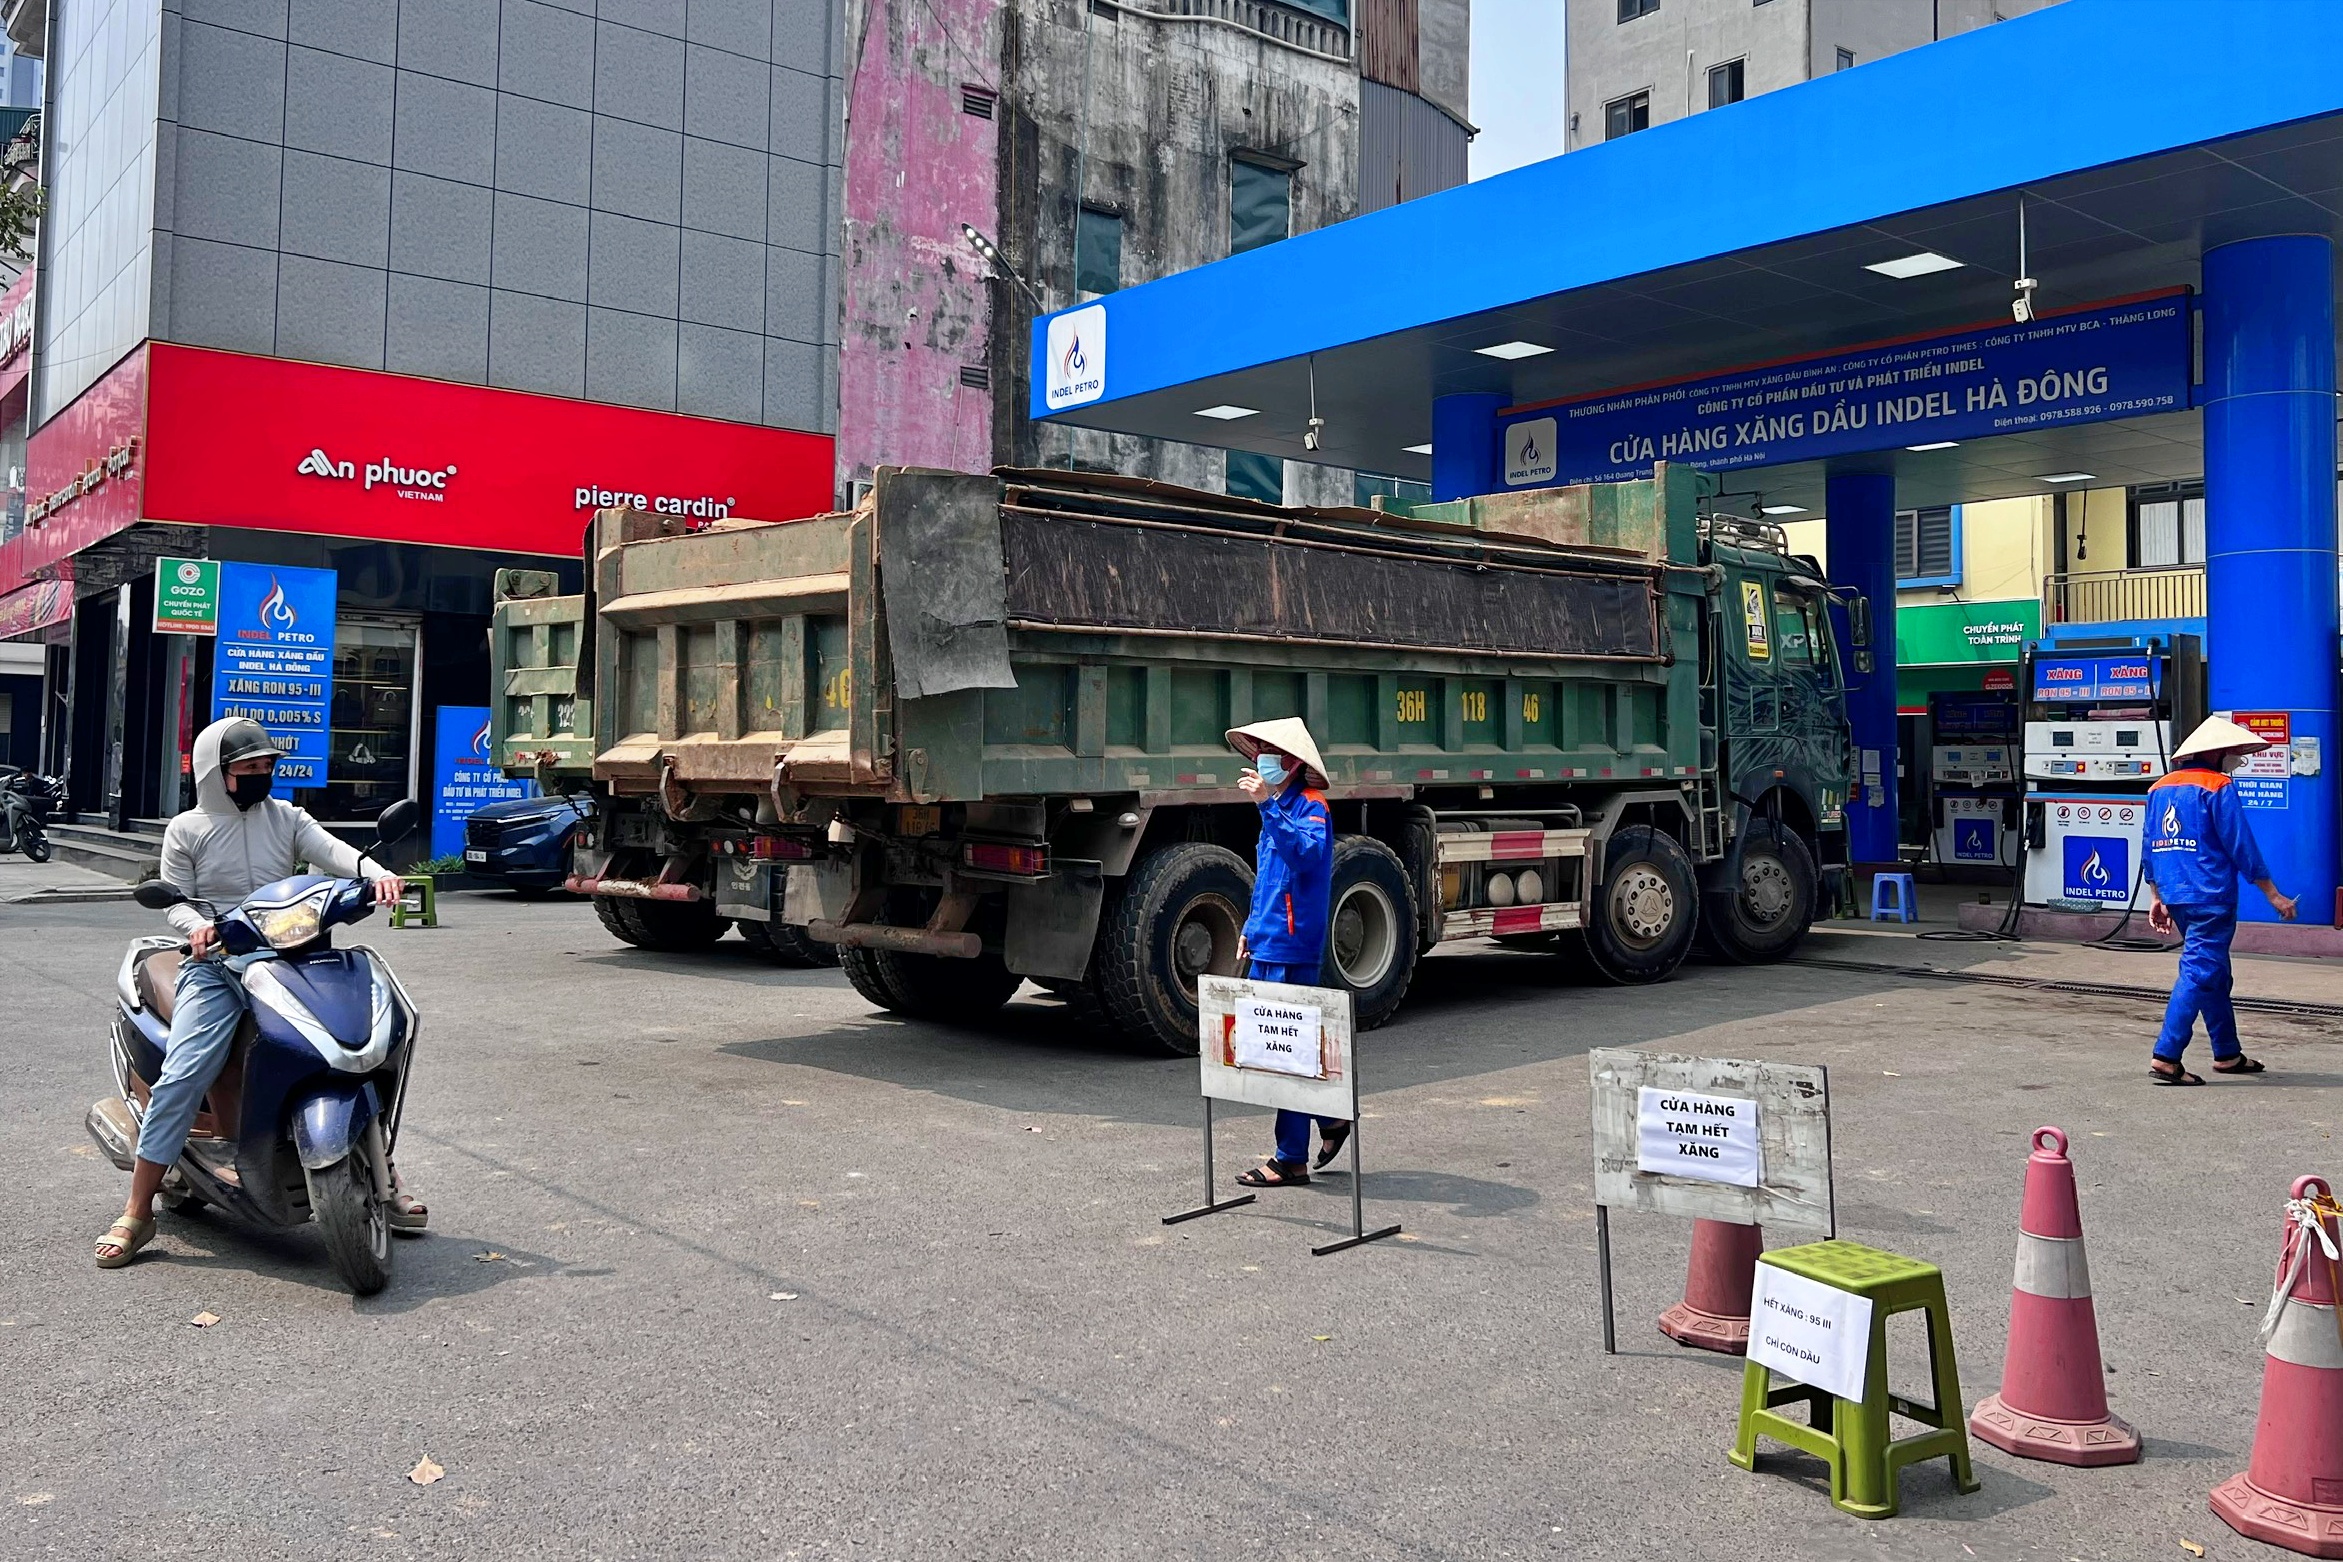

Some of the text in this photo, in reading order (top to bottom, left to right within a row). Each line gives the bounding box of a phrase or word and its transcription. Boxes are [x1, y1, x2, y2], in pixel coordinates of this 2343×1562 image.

[1711, 386, 1720, 394] TY
[1722, 383, 1742, 392] TNHH
[1744, 379, 1760, 389] MTV
[1825, 365, 1837, 374] AN
[1868, 358, 1879, 366] TY
[1920, 346, 1949, 358] PETRO
[1951, 341, 1977, 353] TIMES
[1985, 335, 2011, 347] CÔNG
[2013, 333, 2025, 343] TY
[2028, 328, 2054, 340] TNHH
[2056, 324, 2078, 335] MTV
[2080, 320, 2100, 331] BCA
[1052, 379, 1099, 399] INDEL PETRO
[1698, 400, 1728, 415] CÔNG
[1731, 397, 1744, 409] TY
[1867, 370, 1900, 388] PHÁT
[1945, 357, 1985, 374] INDEL
[1610, 366, 2108, 464] CỬA HÀNG XĂNG DẦU INDEL HÀ ĐÔNG
[1510, 466, 1551, 479] INDEL PETRO
[397, 490, 444, 502] VIETNAM
[575, 485, 647, 510] pierre
[170, 585, 206, 597] GOZO
[2000, 621, 2024, 632] PHÁT
[238, 629, 315, 643] INDEL PETRO
[1968, 633, 2021, 645] TOÀN TRÌNH
[2135, 637, 2140, 647] 1
[239, 661, 265, 670] INDEL
[2110, 665, 2148, 679] XĂNG
[2046, 668, 2082, 681] XĂNG
[262, 682, 286, 694] RON
[2037, 688, 2057, 698] RON
[2060, 687, 2071, 697] 95
[2101, 686, 2122, 697] RON
[2123, 686, 2136, 696] 95
[1397, 691, 1539, 723] 36H 118 46
[314, 711, 321, 724] S
[278, 764, 313, 777] 24/24
[473, 772, 481, 782] TY
[2065, 887, 2126, 899] INDEL PETRO
[1253, 1006, 1303, 1020] CỬA HÀNG
[1258, 1024, 1299, 1037] TẠM HẾT
[1266, 1041, 1292, 1053] XĂNG
[1660, 1097, 1735, 1117] CỬA HÀNG
[1666, 1121, 1729, 1137] TẠM HẾT
[1679, 1142, 1719, 1159] XĂNG
[1763, 1297, 1779, 1310] HẾT
[1780, 1303, 1804, 1320] XĂNG
[1810, 1314, 1821, 1326] 95
[1822, 1318, 1832, 1329] III
[1765, 1335, 1821, 1364] CHỈ CÒN DẦU
